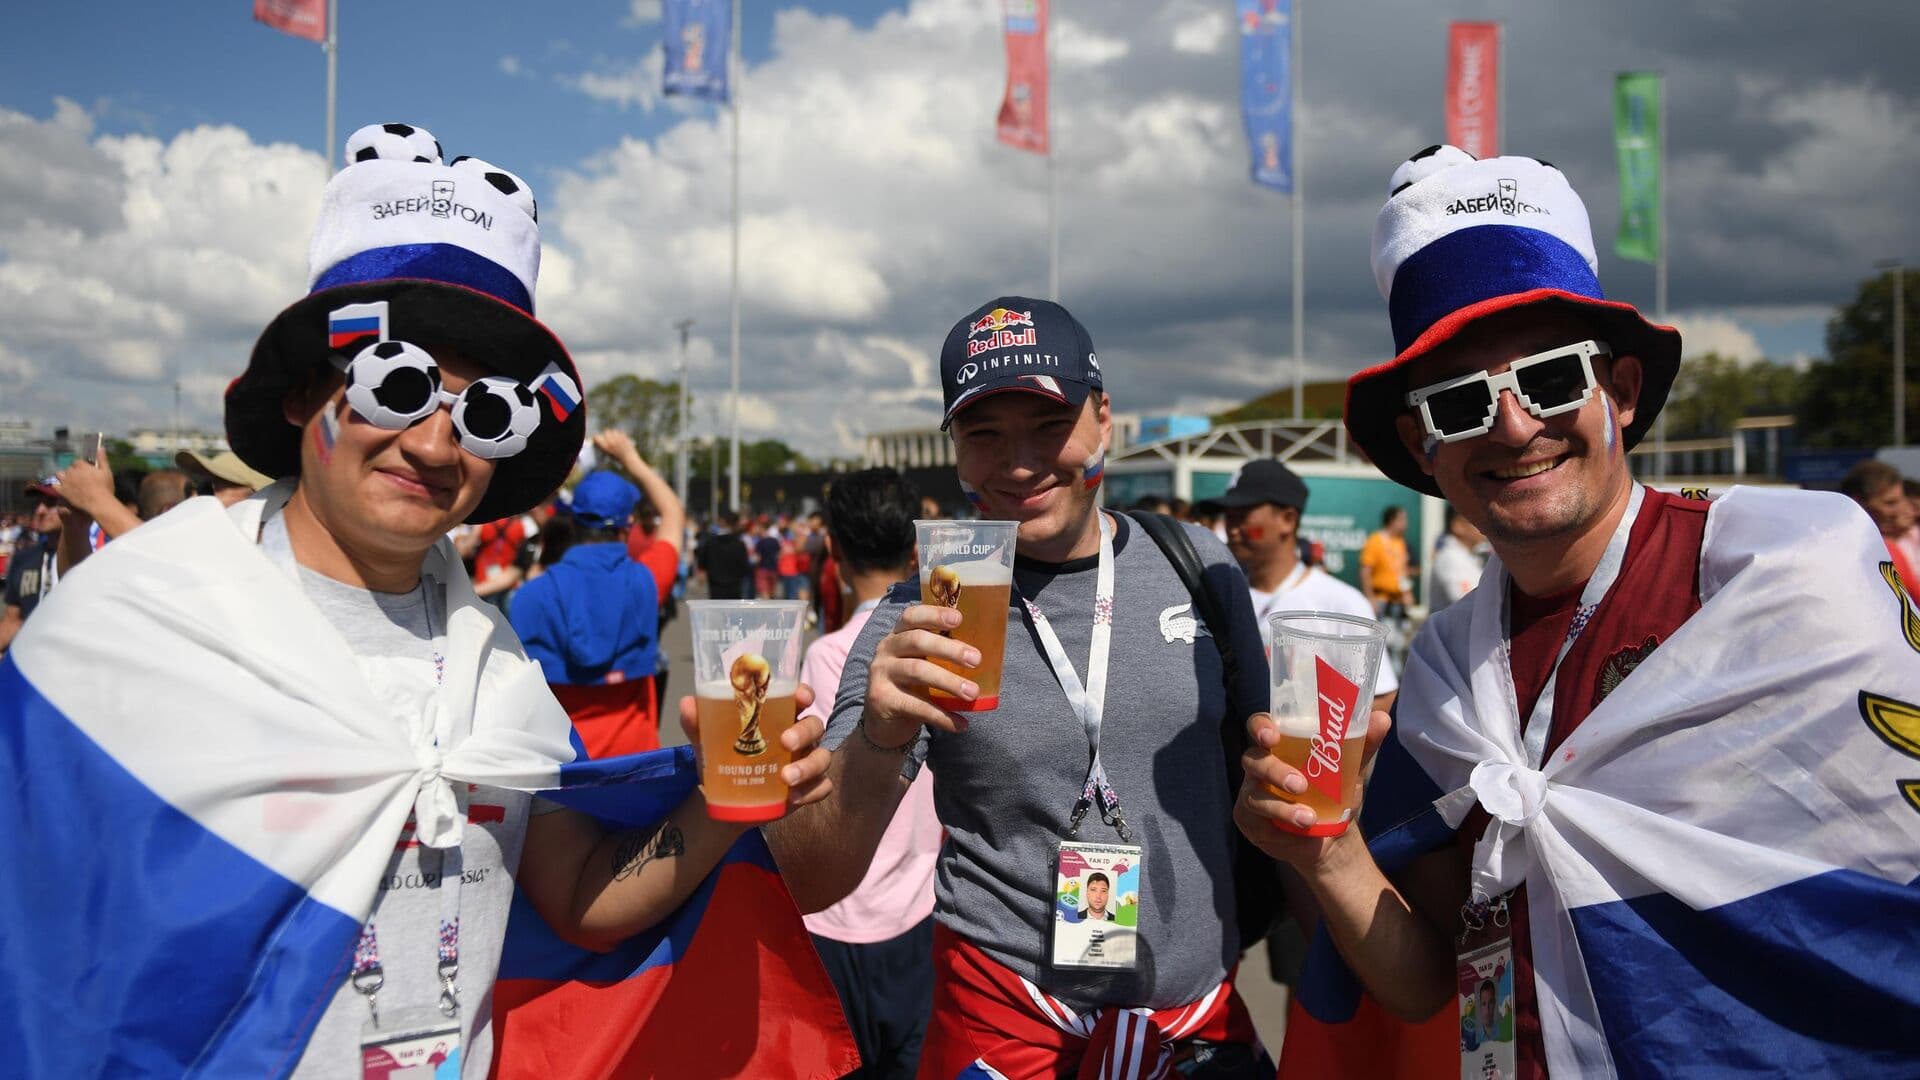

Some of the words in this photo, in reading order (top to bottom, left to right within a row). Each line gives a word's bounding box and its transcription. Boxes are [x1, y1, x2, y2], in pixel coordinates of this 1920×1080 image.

[453, 203, 493, 231] ГОЛ!
[1446, 193, 1499, 216] ЗАБЕЙ
[967, 331, 1000, 358] Red
[1000, 328, 1037, 347] Bull
[983, 353, 1059, 371] INFINITI
[1308, 692, 1346, 778] Bud
[718, 764, 752, 776] ROUND
[754, 763, 767, 775] OF
[768, 762, 778, 774] 16
